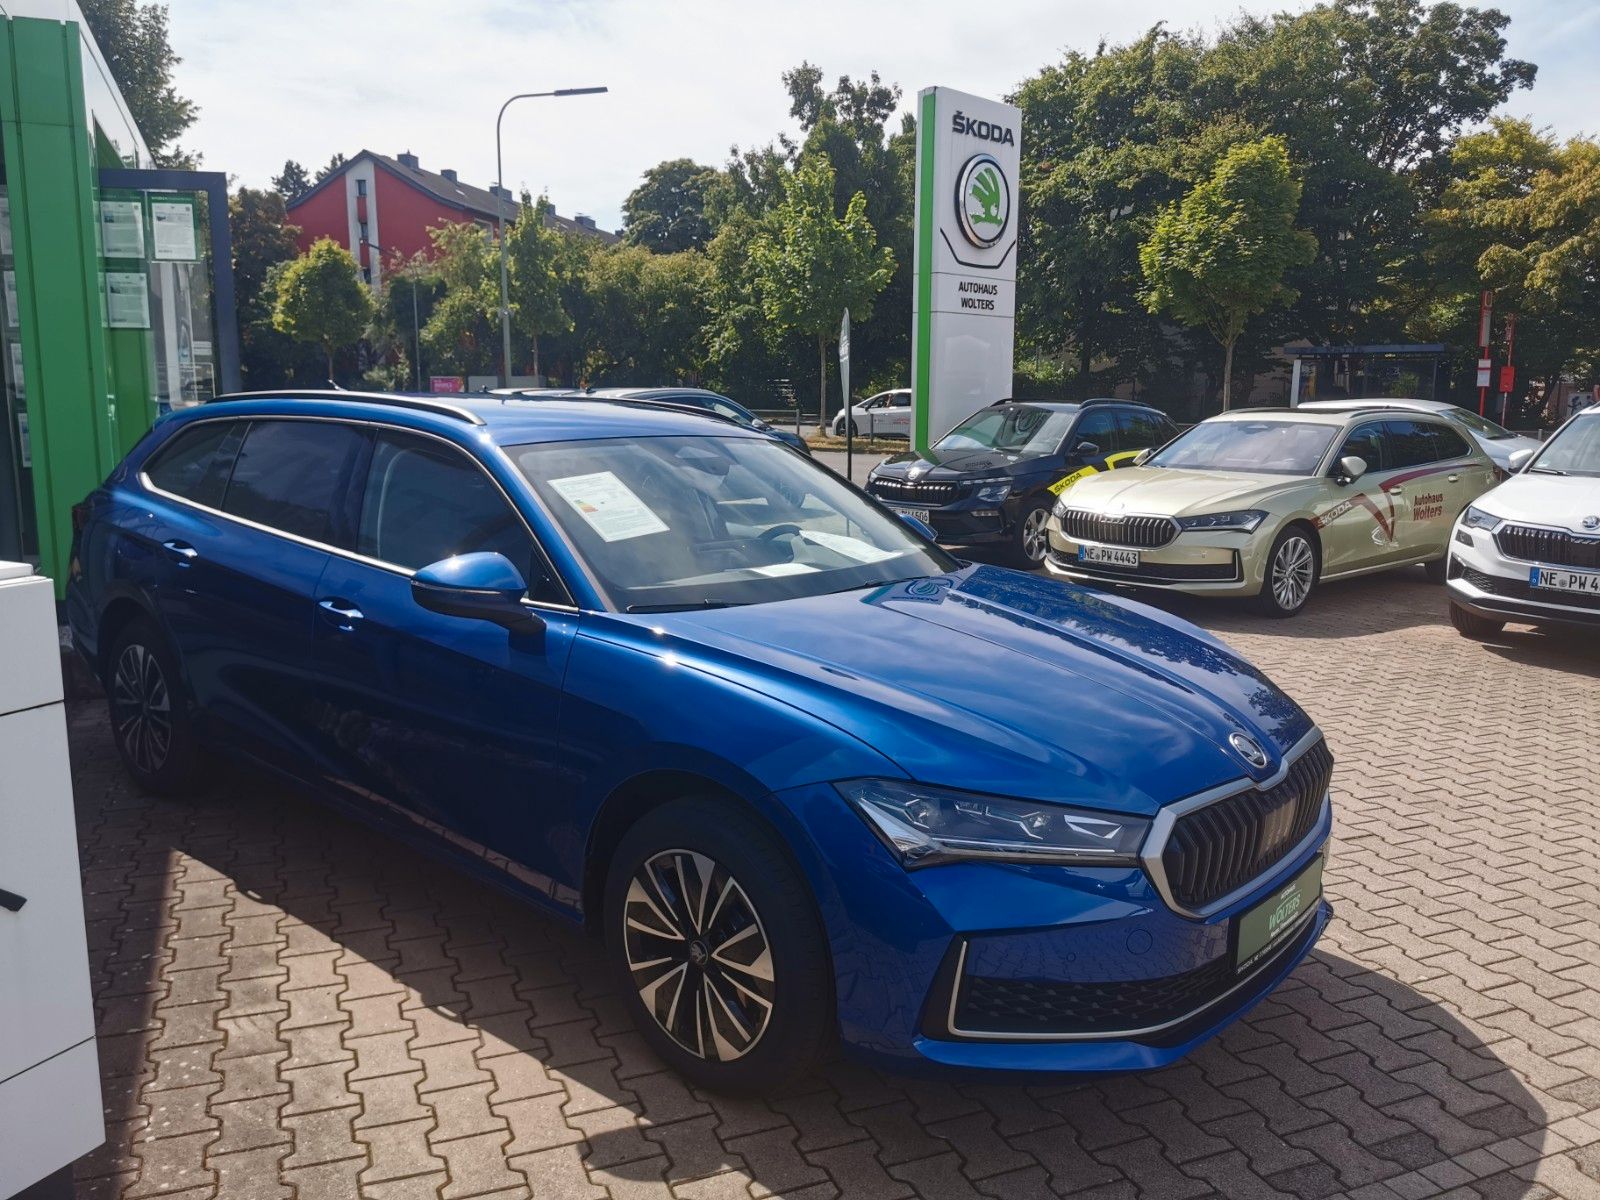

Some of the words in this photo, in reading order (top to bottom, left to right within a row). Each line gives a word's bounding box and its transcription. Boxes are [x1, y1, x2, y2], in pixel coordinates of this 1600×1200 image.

[952, 110, 1015, 147] ŠKODA
[958, 281, 998, 295] AUTOHAUS
[961, 297, 995, 311] WOLTERS
[1414, 493, 1444, 507] Autohaus
[1413, 505, 1443, 521] Wolters
[1085, 548, 1095, 560] NE
[1101, 549, 1113, 561] PW
[1114, 551, 1137, 565] 4443
[1540, 571, 1557, 586] NE
[1569, 574, 1588, 590] PW
[1591, 577, 1600, 591] 4
